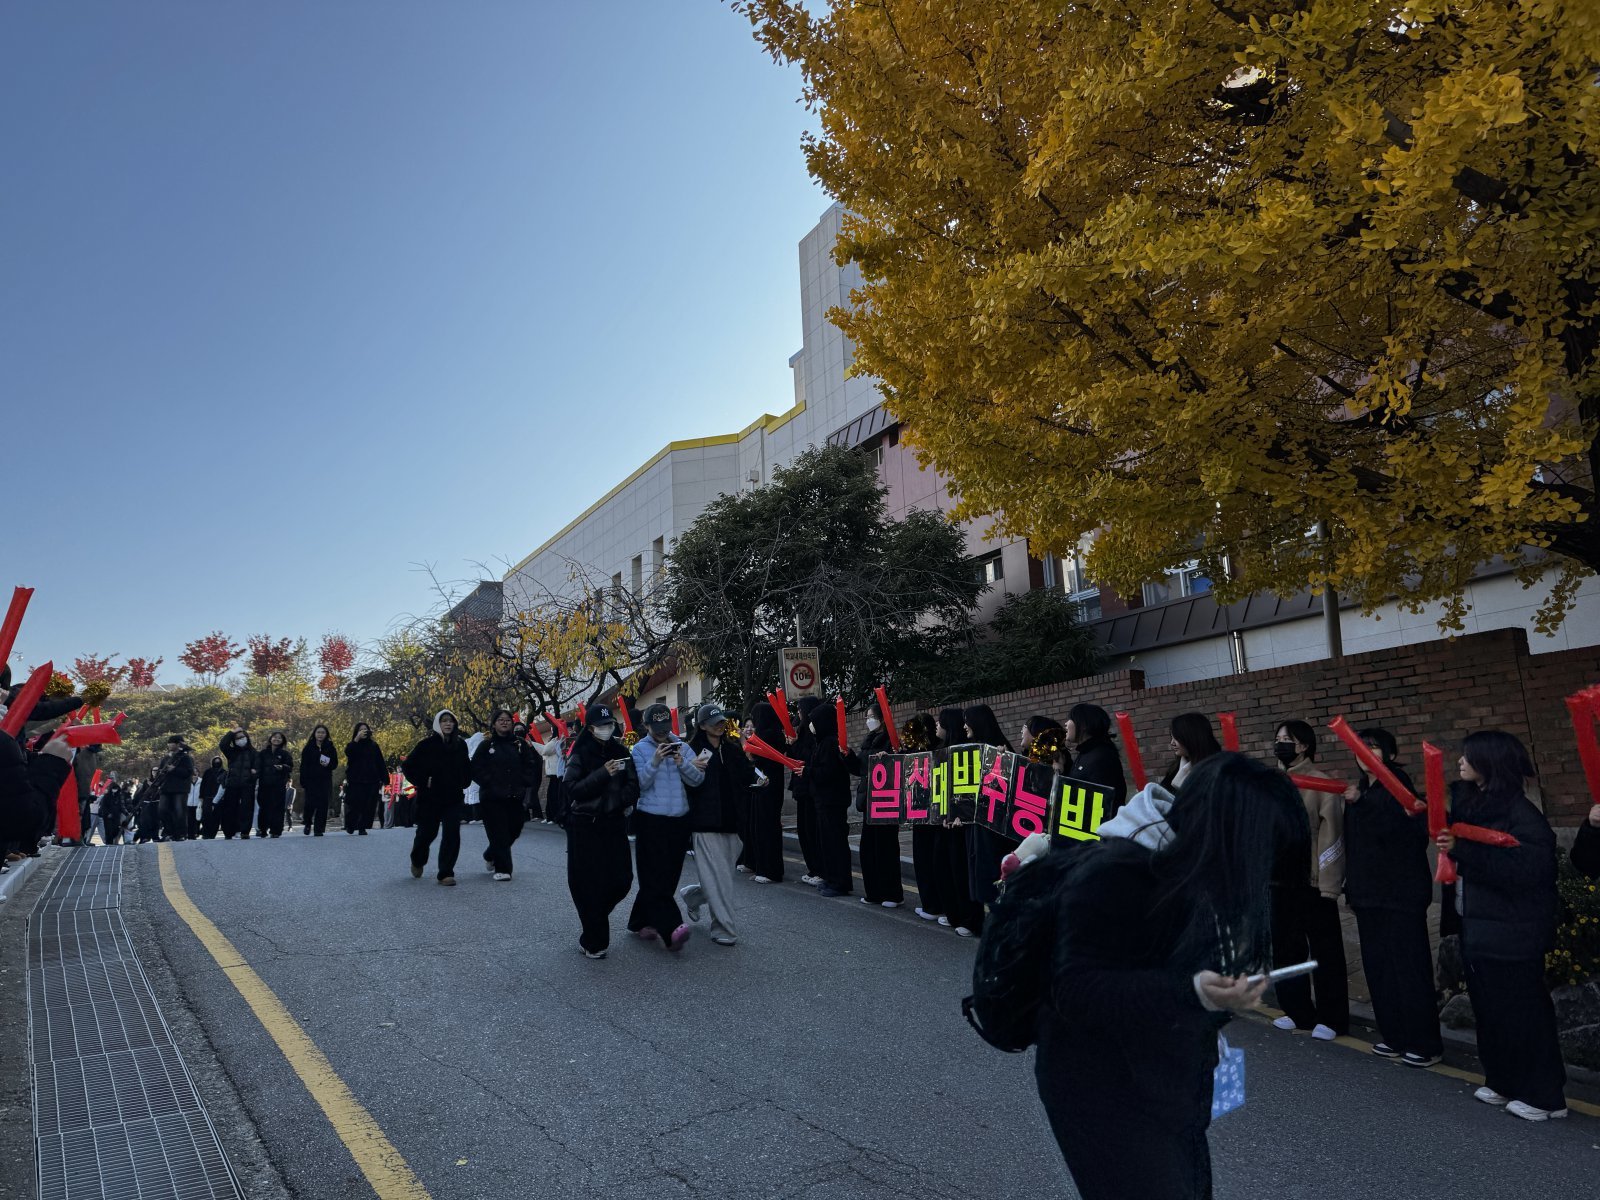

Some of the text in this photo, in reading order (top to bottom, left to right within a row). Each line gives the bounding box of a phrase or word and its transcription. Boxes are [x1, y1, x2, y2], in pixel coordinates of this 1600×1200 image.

[601, 708, 609, 717] NY
[870, 756, 929, 819] 일신
[932, 749, 982, 816] 대박
[981, 754, 1047, 838] 수능
